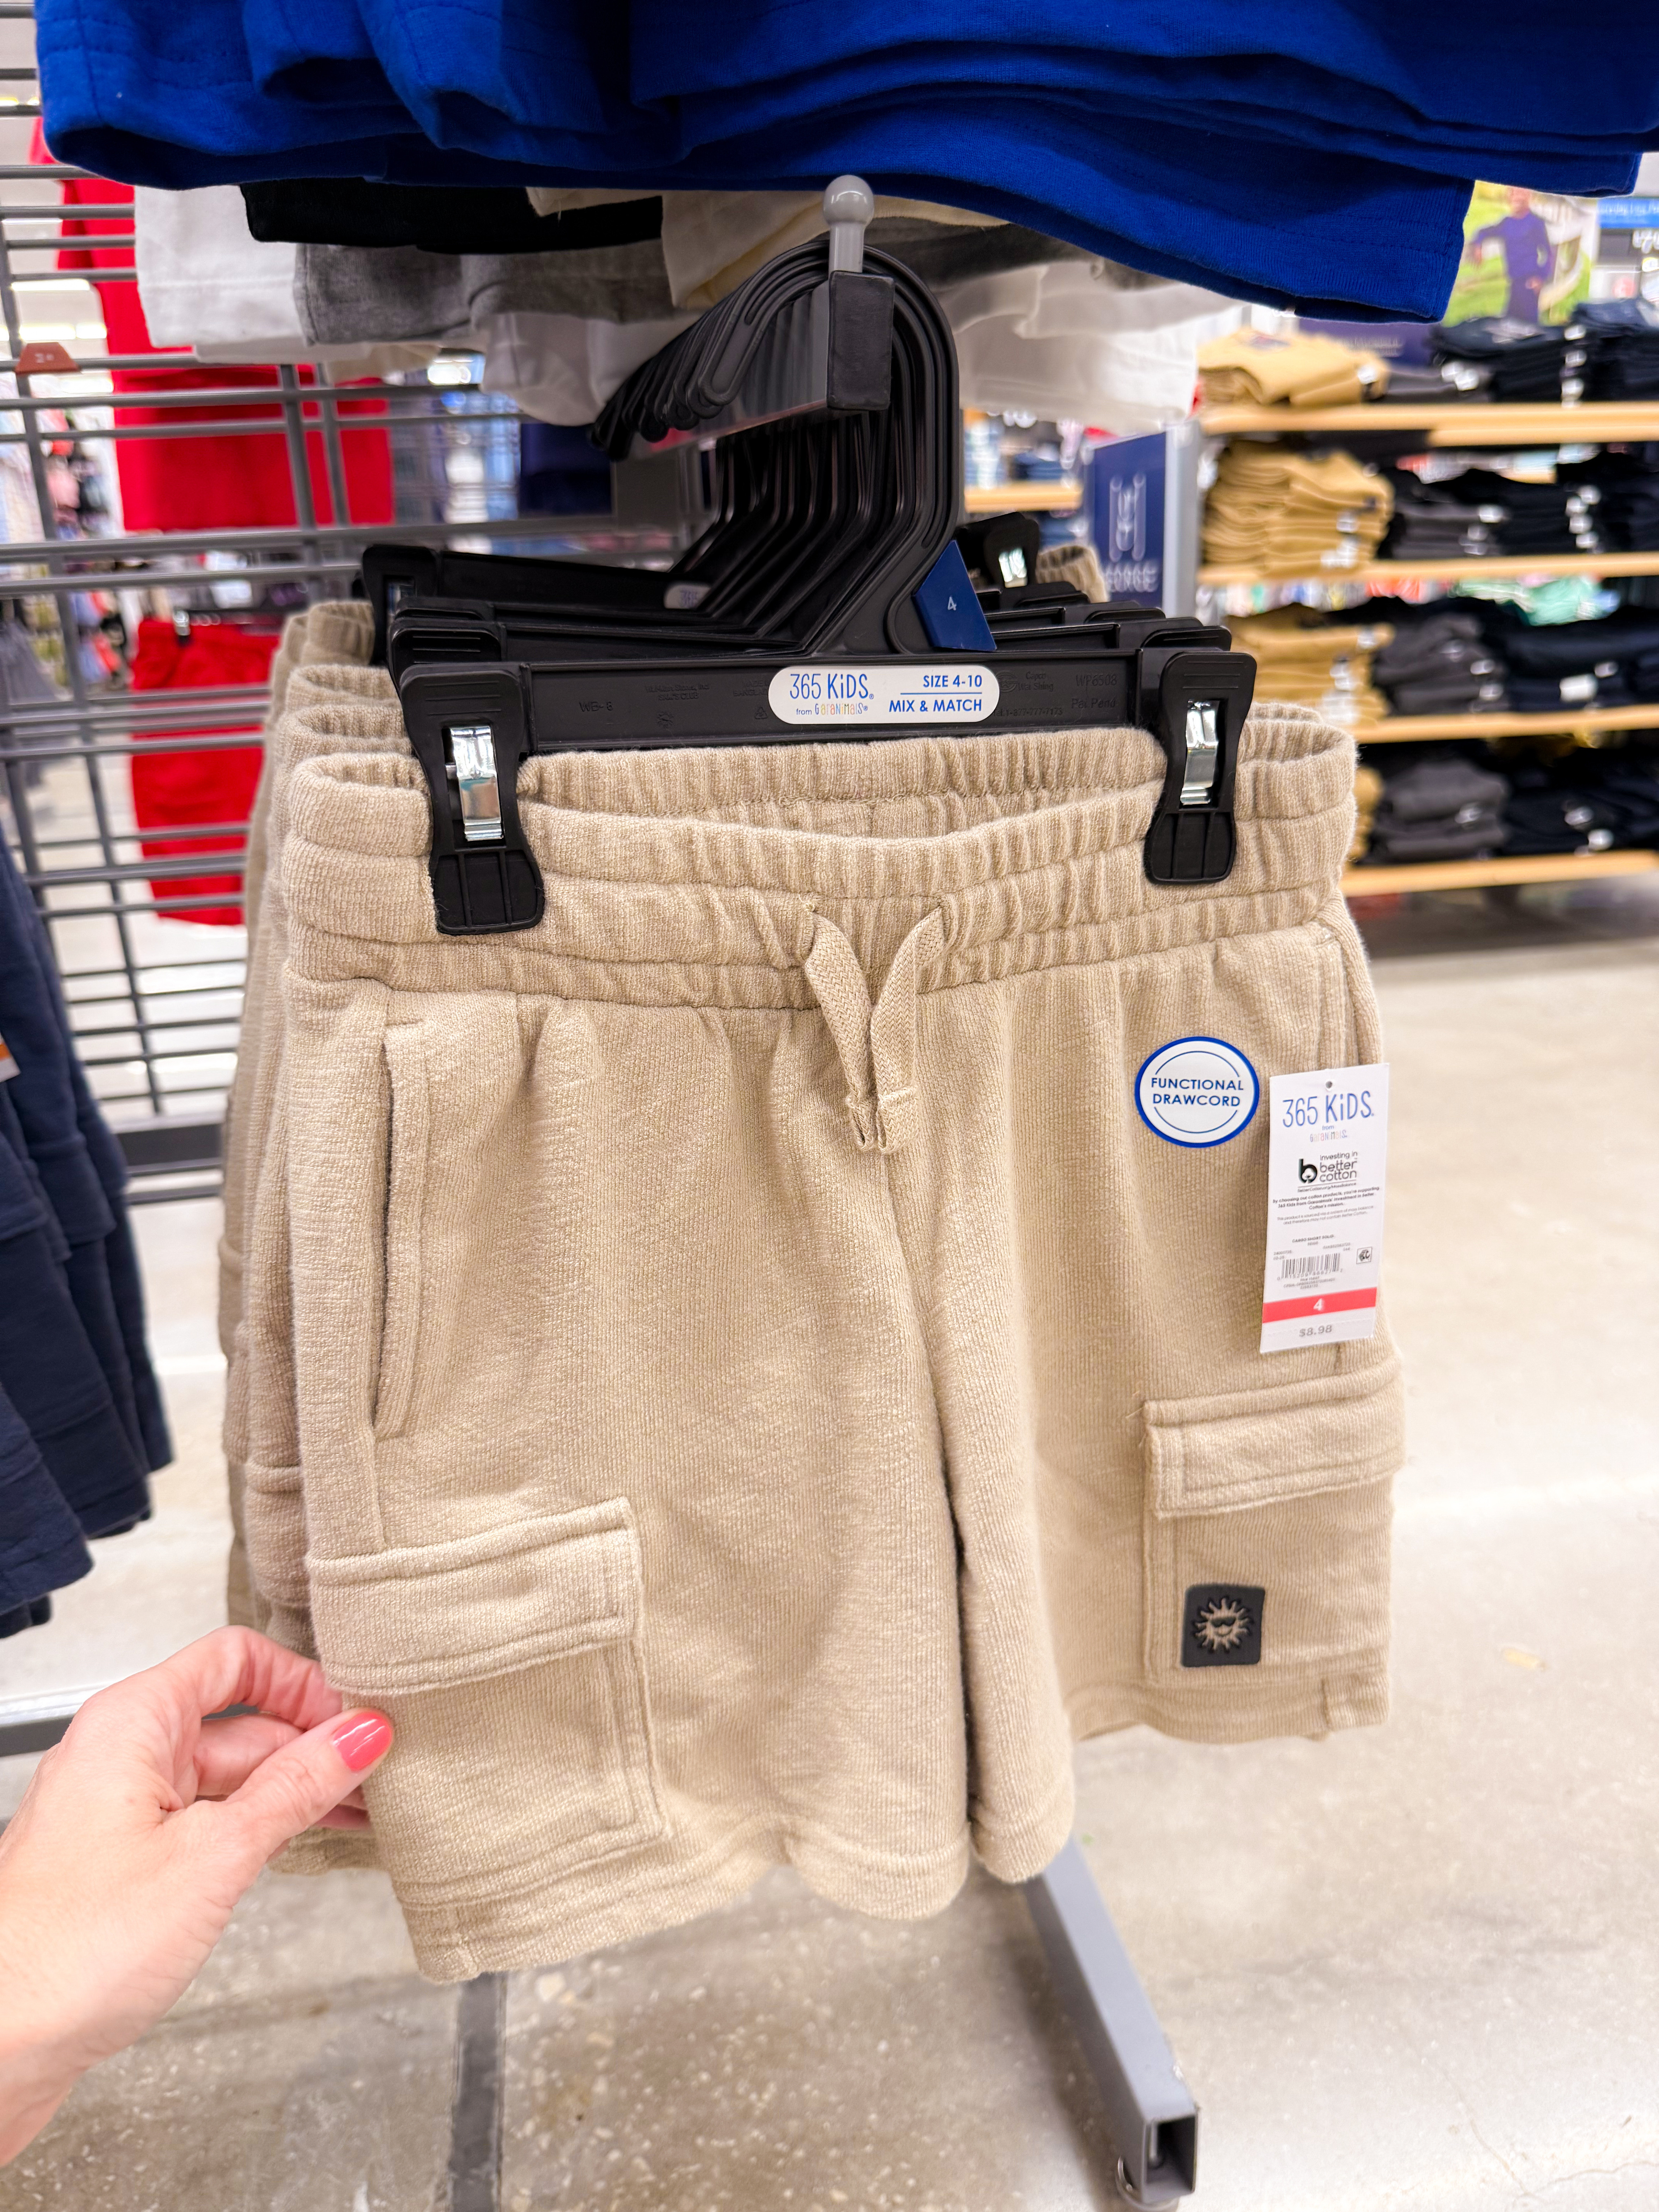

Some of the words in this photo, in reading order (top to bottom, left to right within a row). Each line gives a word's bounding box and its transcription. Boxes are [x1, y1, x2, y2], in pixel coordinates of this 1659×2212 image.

[948, 596, 957, 611] 4
[790, 673, 821, 699] 365
[923, 675, 949, 688] SIZE
[953, 674, 982, 688] 4-10
[889, 700, 916, 713] MIX
[920, 700, 929, 713] &
[933, 699, 982, 712] MATCH
[1151, 1077, 1243, 1090] FUNCTIONAL
[1153, 1093, 1240, 1107] DRAWCORD
[1283, 1096, 1318, 1128] 365
[1320, 1152, 1350, 1161] investing
[1320, 1159, 1358, 1173] better
[1319, 1169, 1357, 1182] cotton
[1313, 1298, 1324, 1312] 4
[1299, 1325, 1332, 1337] $8.98
